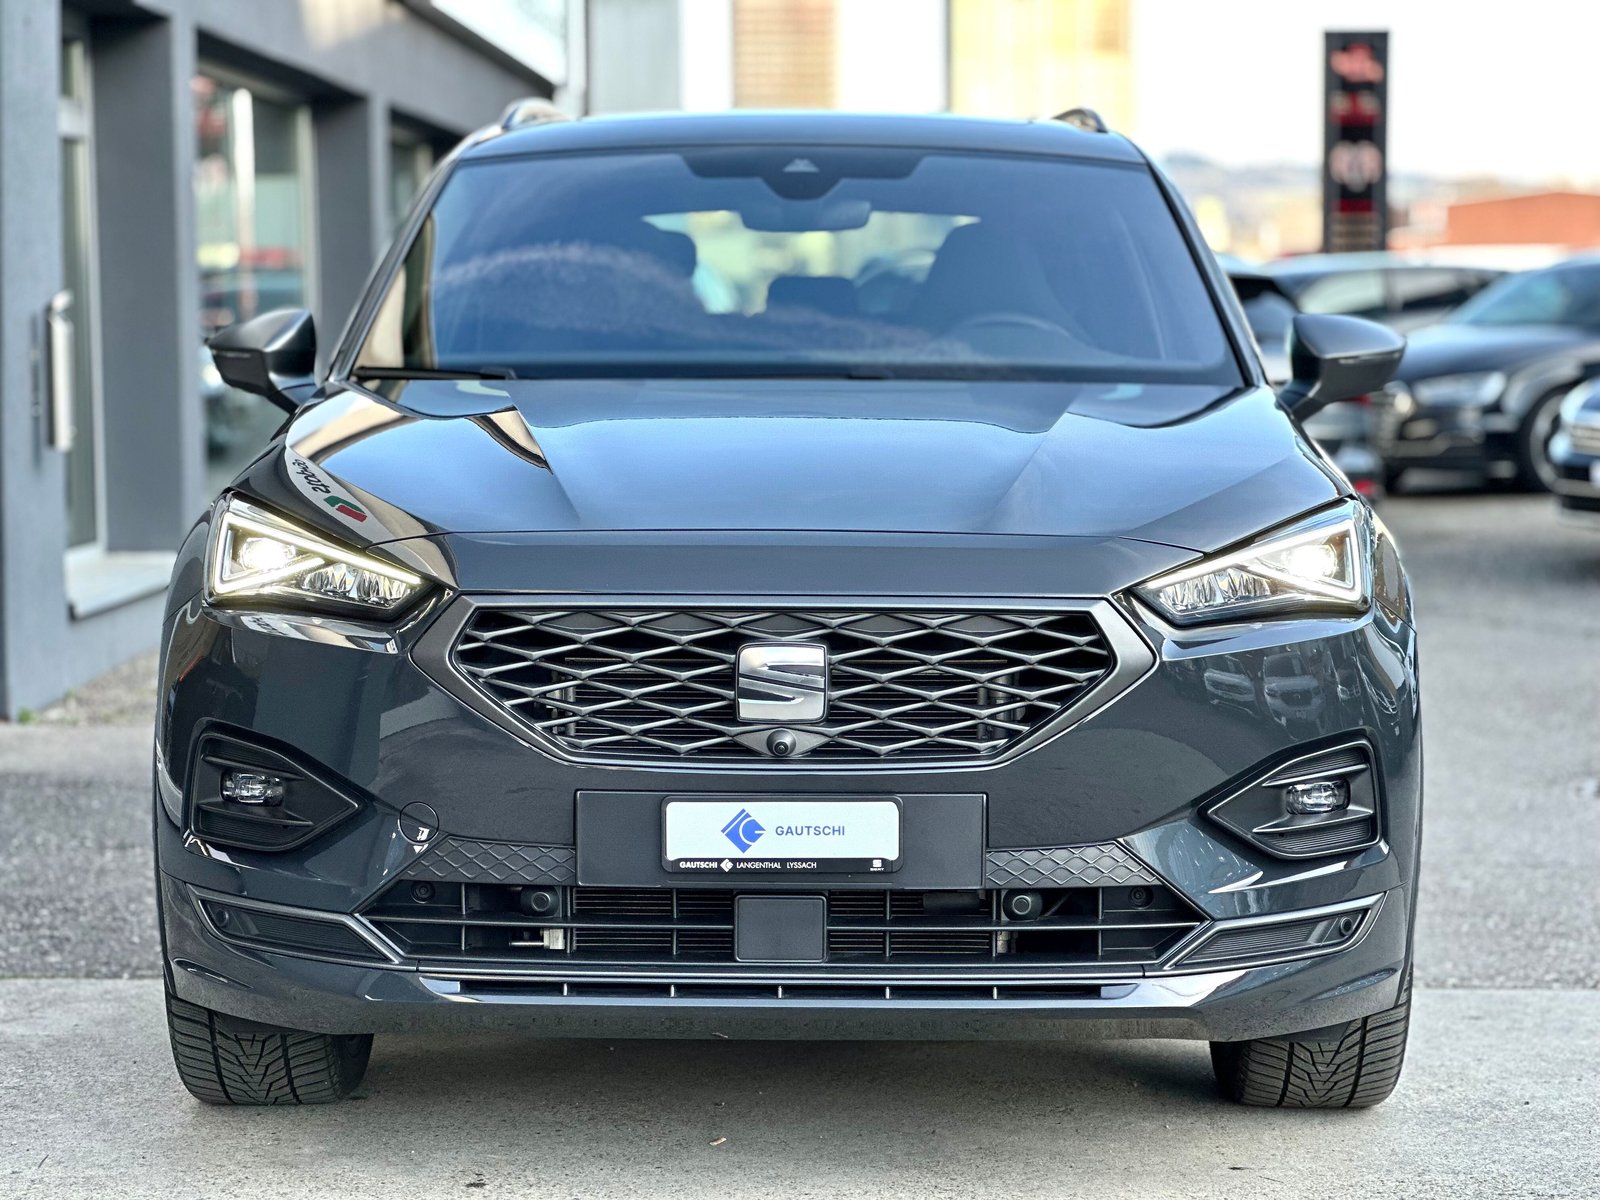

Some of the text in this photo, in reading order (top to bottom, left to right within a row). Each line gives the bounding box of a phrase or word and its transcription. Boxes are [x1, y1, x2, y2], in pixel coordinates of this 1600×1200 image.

[775, 825, 845, 836] GAUTSCHI
[679, 861, 817, 869] GAUTSCHI LANGENTHAL LYSSACH
